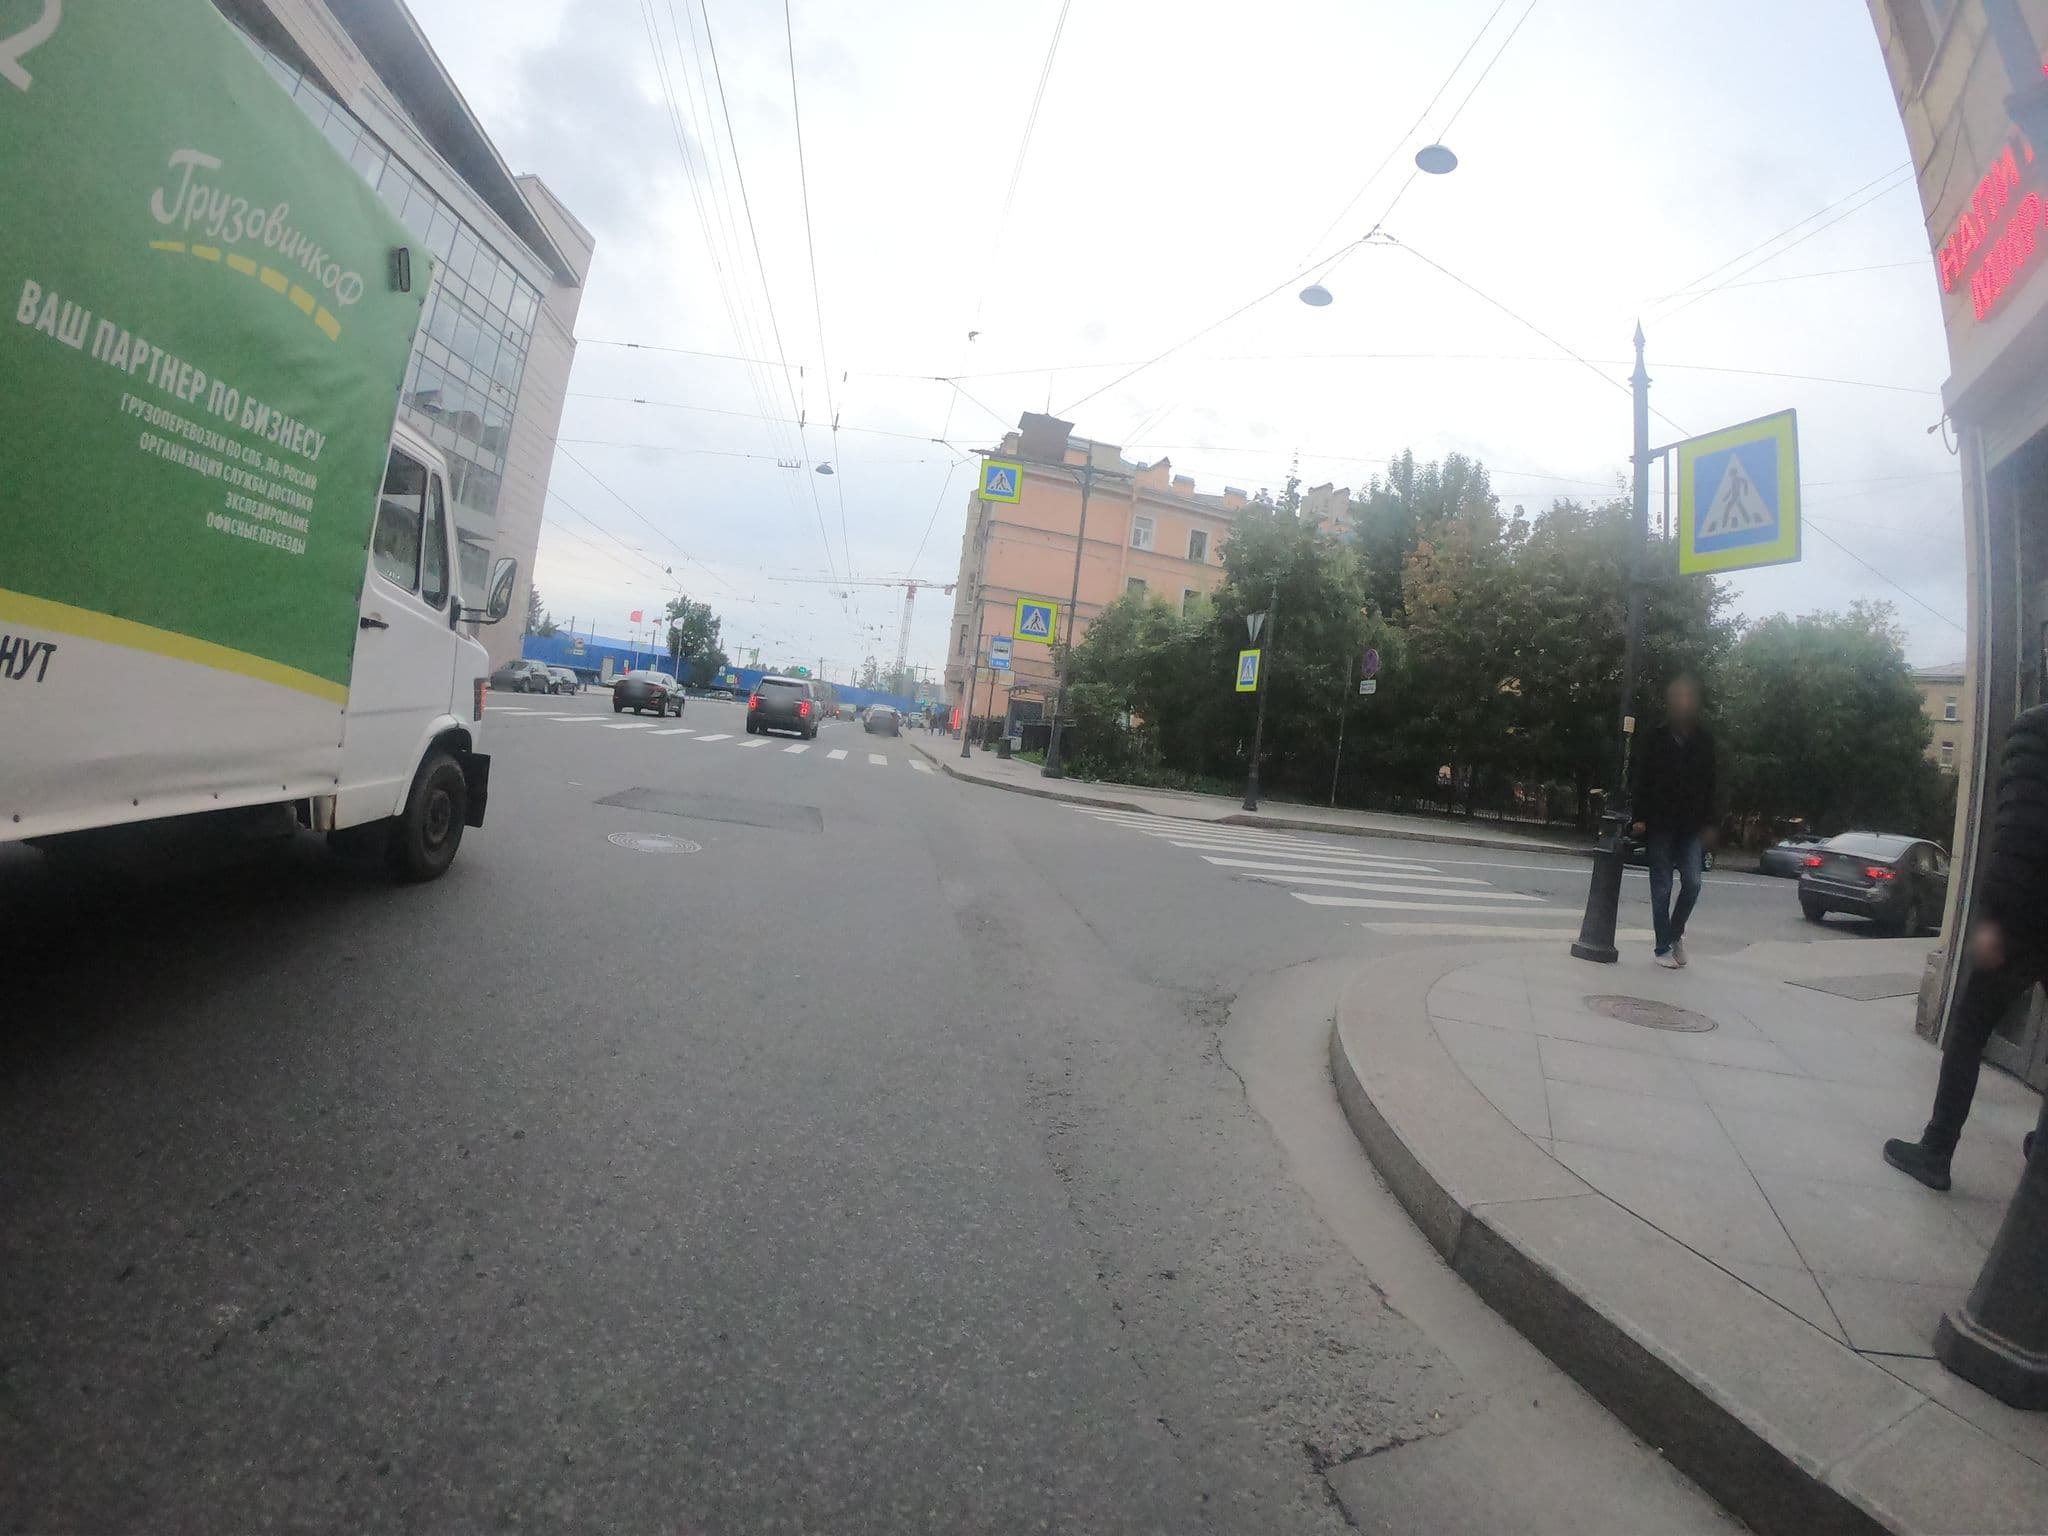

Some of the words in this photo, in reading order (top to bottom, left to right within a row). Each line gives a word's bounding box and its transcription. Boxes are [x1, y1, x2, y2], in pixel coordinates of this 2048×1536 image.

[1938, 122, 2034, 293] НАПИ
[16, 279, 91, 350] ВАШ
[91, 318, 207, 403] ПАРТНЕР
[206, 378, 241, 423] ПО
[240, 395, 326, 462] БИЗНЕСУ
[120, 391, 226, 453] ГРУЗОПЕРЕВОЗКИ
[226, 439, 242, 459] ПО
[139, 431, 223, 478] ОРГАНИЗАЦИЯ
[223, 465, 268, 495] СЛУЖБЫ
[266, 482, 314, 513] ДОСТАВКИ
[206, 511, 260, 541] ОФИСНЫЕ
[258, 526, 306, 555] ПЕРЕЕЗДЫ
[0, 635, 58, 682] НУТ
